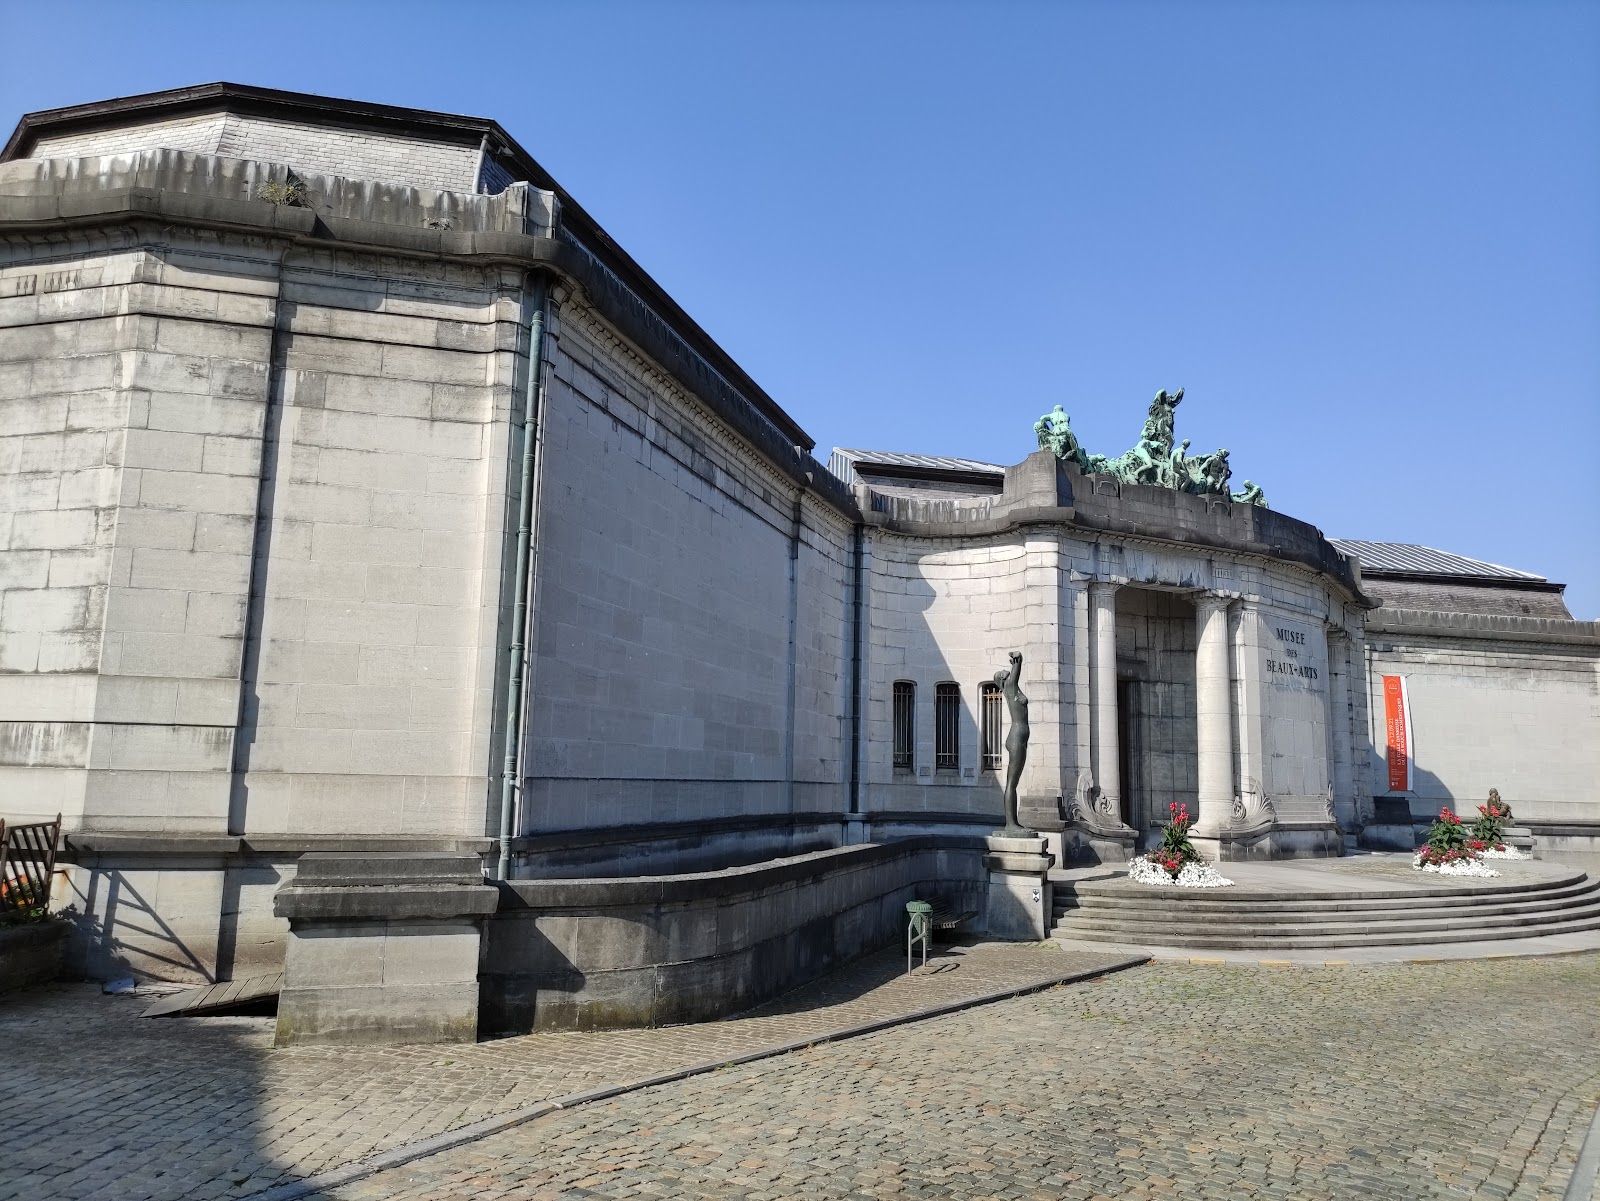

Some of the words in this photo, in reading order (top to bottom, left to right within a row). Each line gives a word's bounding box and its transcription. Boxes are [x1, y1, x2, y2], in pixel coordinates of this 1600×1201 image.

[1276, 628, 1305, 644] MUSEE
[1286, 649, 1297, 658] DES
[1266, 660, 1318, 679] BEAUX-ARTS
